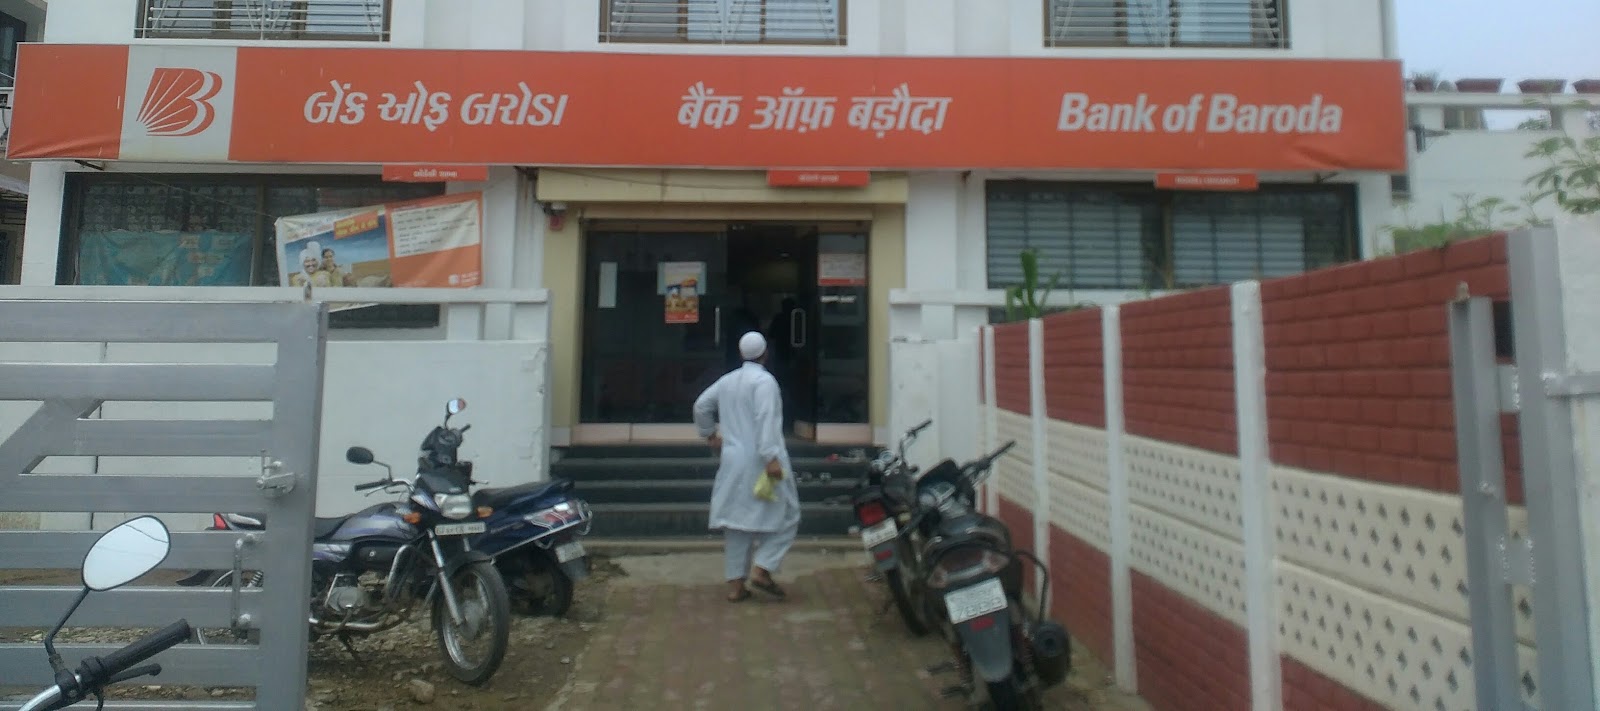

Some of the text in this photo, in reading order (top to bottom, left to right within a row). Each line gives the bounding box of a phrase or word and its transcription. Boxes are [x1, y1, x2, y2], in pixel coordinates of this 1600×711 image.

[303, 79, 569, 132] બેંક ઓફ બરોડા
[677, 80, 743, 129] बैंक
[847, 82, 953, 138] बड़ौदा
[1056, 92, 1343, 134] Bank of Baroda
